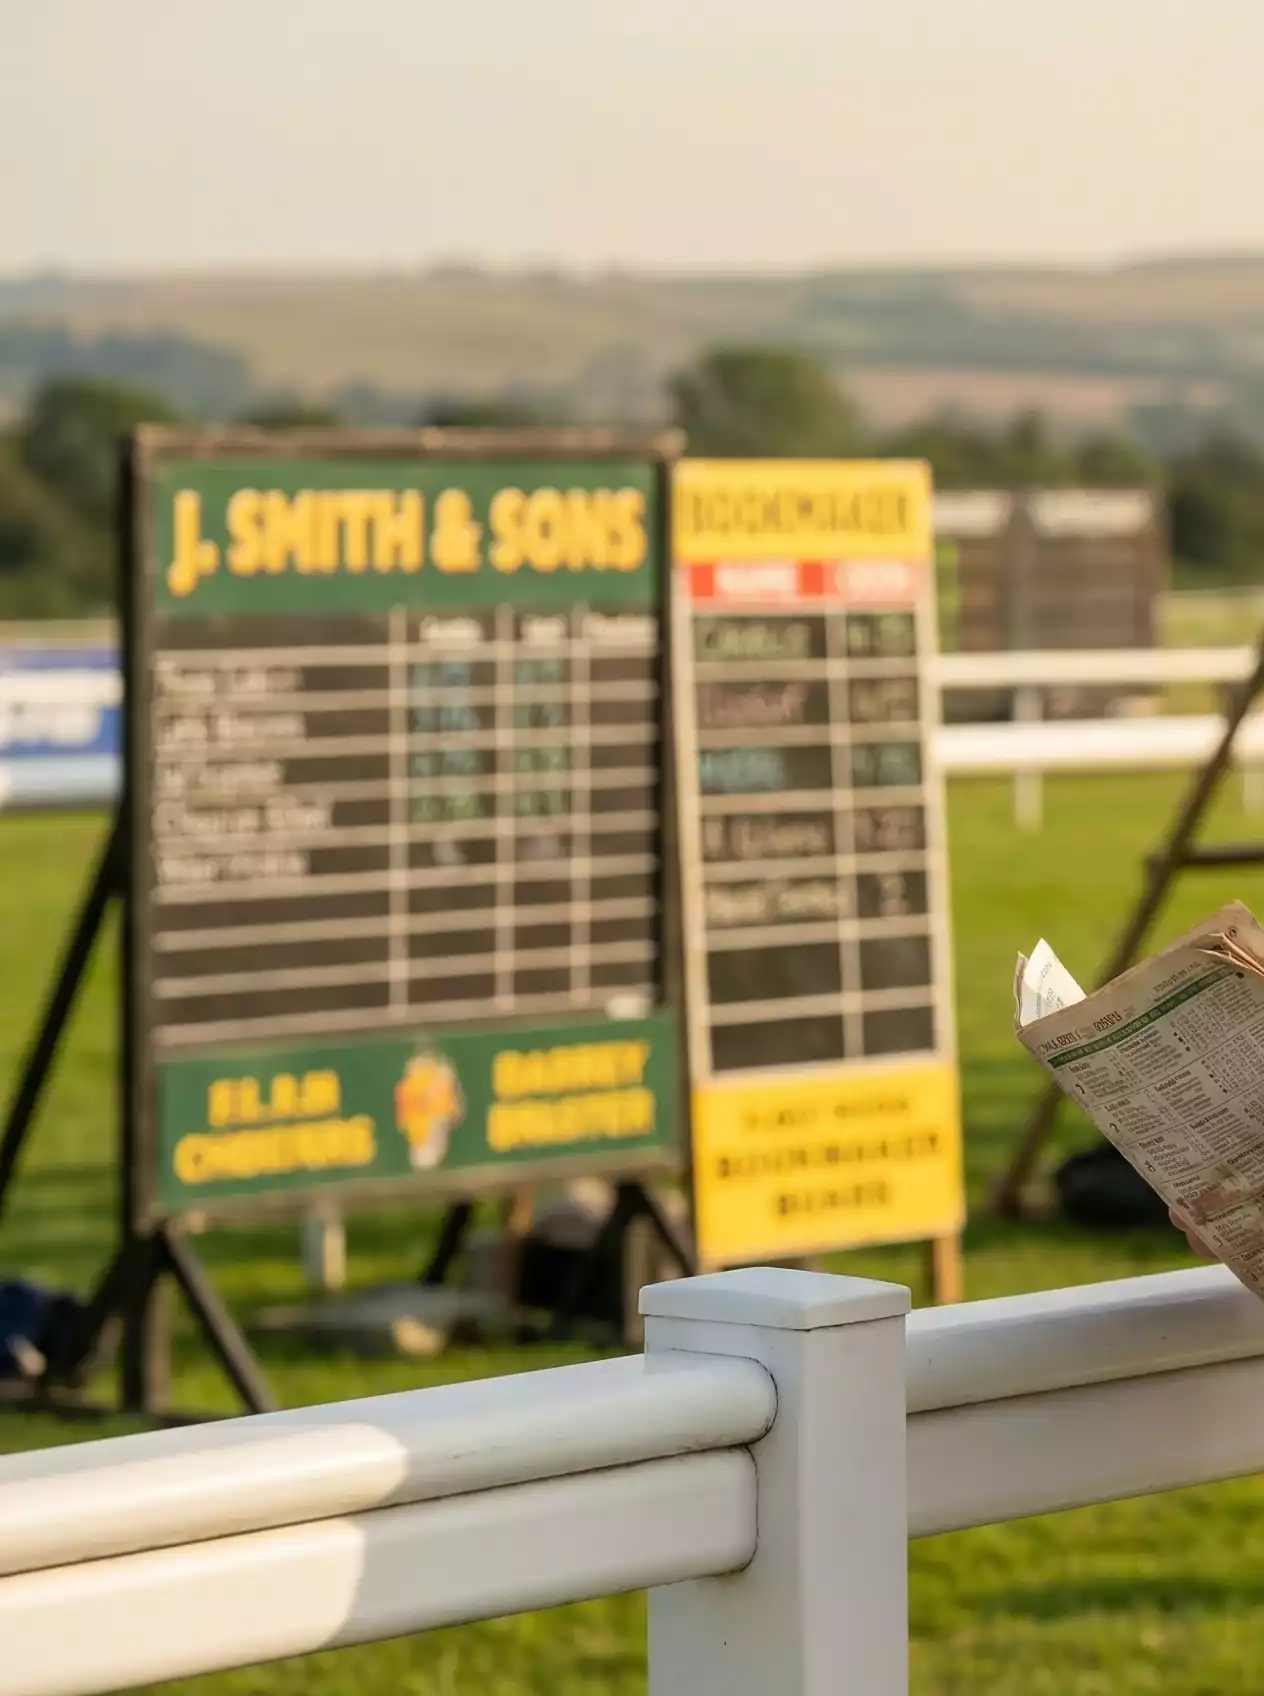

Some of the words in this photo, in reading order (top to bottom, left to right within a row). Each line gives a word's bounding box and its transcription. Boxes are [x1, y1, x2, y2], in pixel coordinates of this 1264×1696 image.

[167, 489, 220, 597] J.
[226, 488, 425, 575] SMITH
[431, 488, 481, 574] &
[489, 487, 647, 573] SONS
